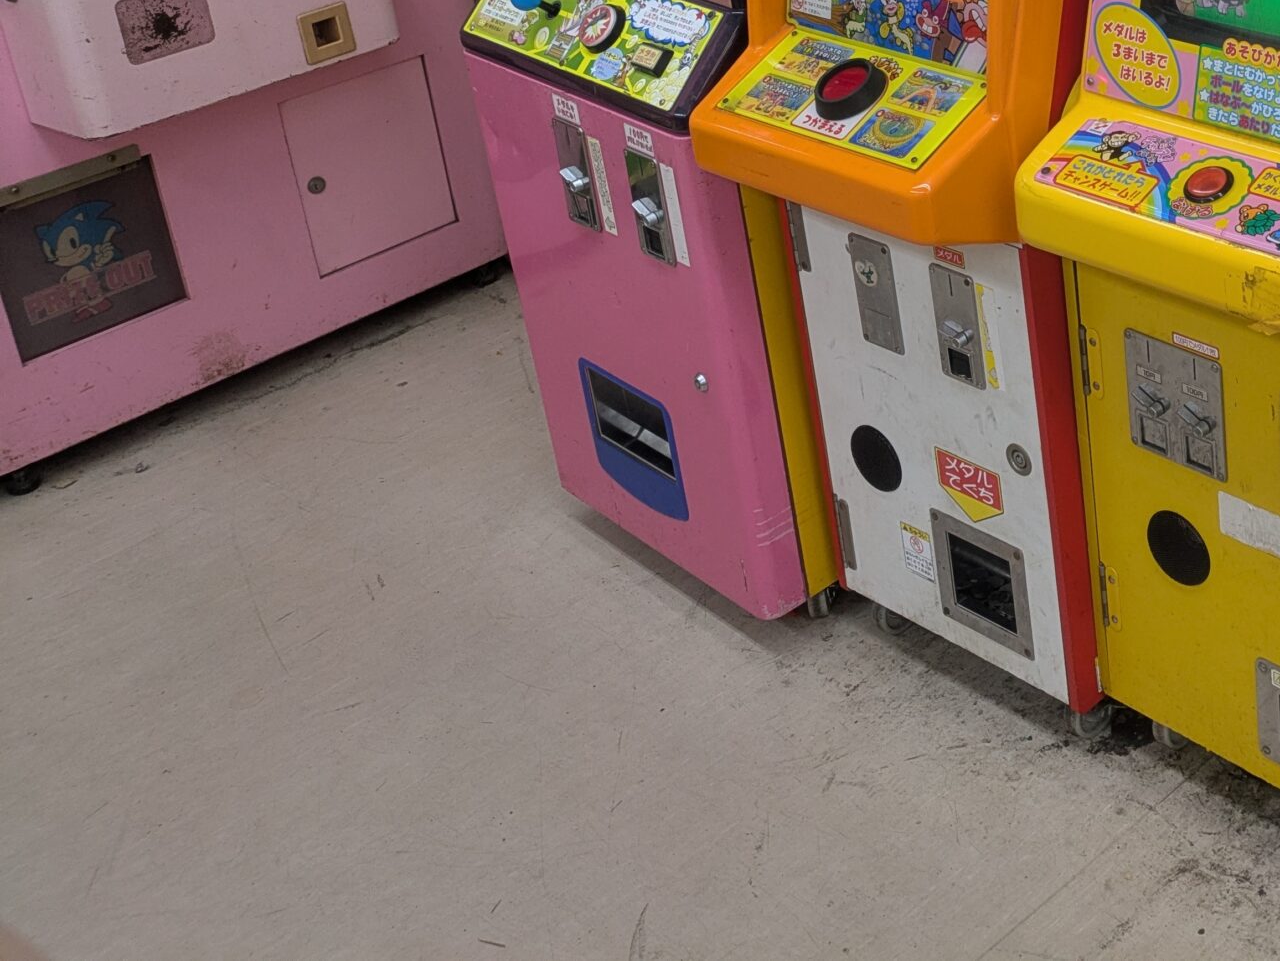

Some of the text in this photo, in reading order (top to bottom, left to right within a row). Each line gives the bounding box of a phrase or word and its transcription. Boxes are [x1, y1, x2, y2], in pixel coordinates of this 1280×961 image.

[1103, 22, 1147, 43] メダルは
[1113, 43, 1168, 69] 3まいまで
[802, 115, 846, 135] つかまえる
[1073, 159, 1146, 188] これがとれたら
[937, 249, 962, 264] メダル
[105, 250, 156, 291] OUT
[945, 457, 993, 488] メダル
